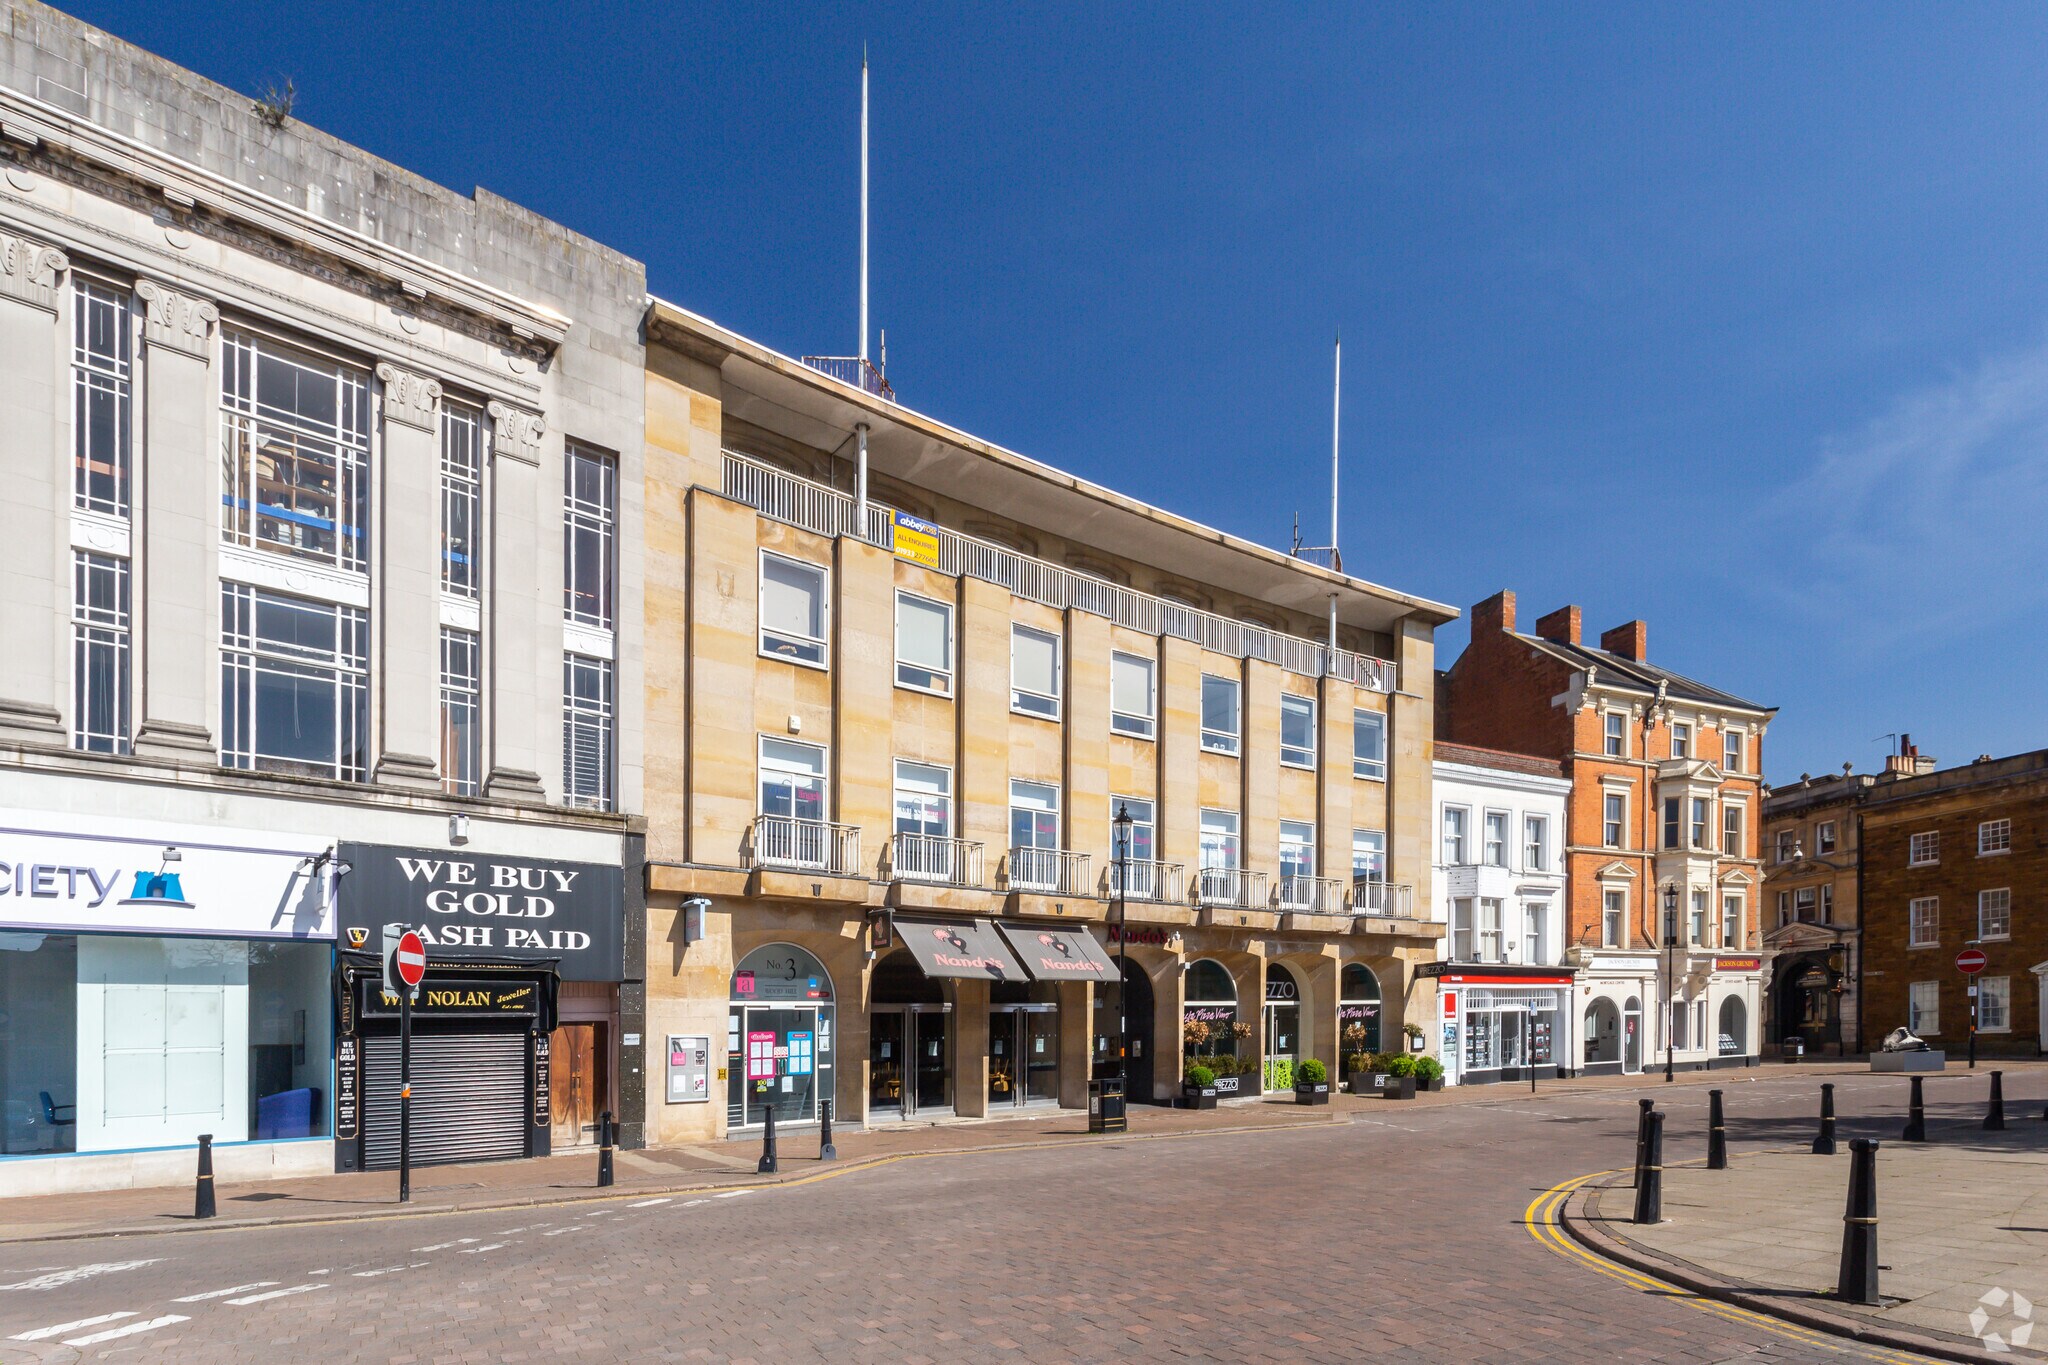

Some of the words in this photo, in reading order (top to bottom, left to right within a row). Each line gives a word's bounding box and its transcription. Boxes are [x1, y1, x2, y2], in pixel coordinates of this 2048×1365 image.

[897, 534, 908, 543] ALL
[395, 857, 477, 886] WE
[489, 864, 580, 892] BUY
[426, 890, 555, 918] GOLD
[387, 922, 494, 947] ASH
[505, 928, 591, 950] PAID
[766, 959, 783, 969] No.
[784, 958, 796, 981] 3
[933, 953, 1005, 969] Nando's
[1040, 957, 1104, 971] Nando's
[427, 991, 491, 1006] NOLAN
[496, 988, 531, 1004] Jeweller
